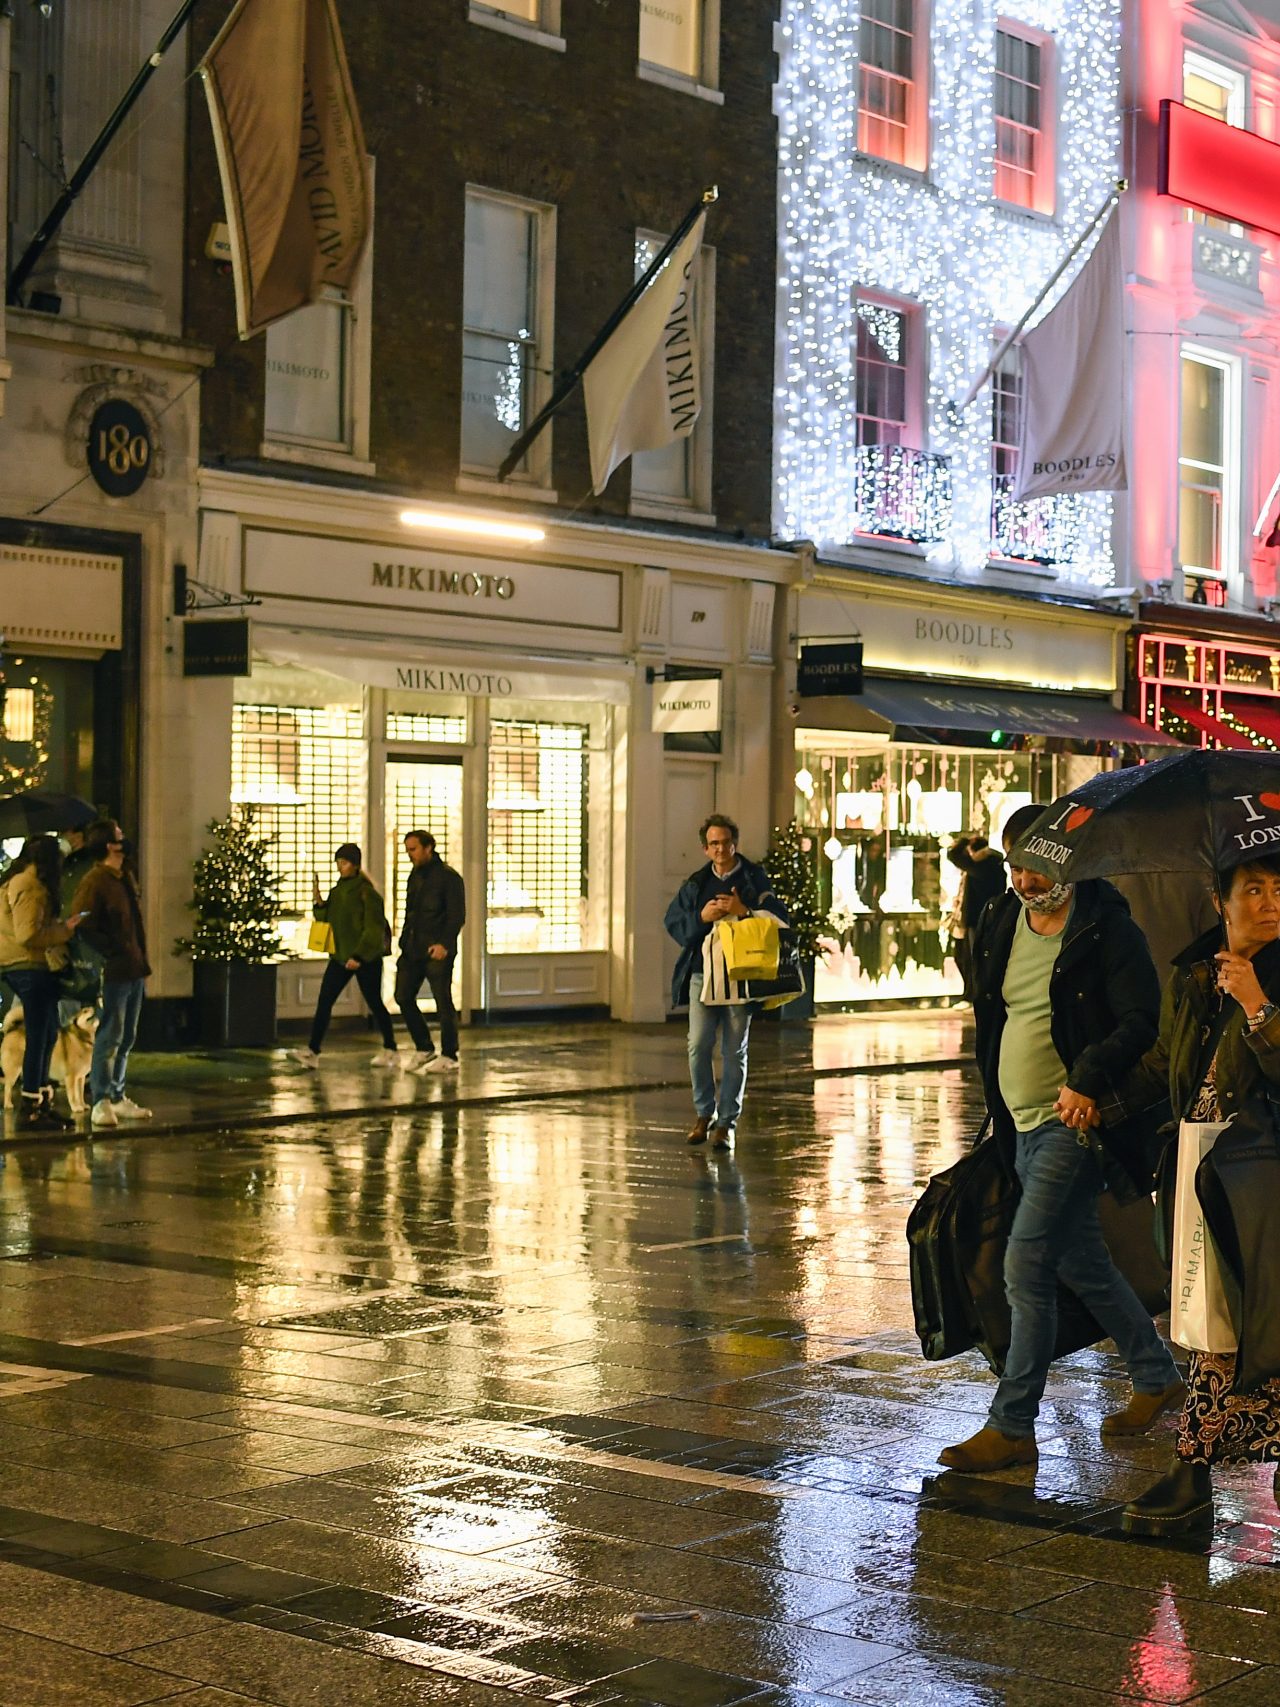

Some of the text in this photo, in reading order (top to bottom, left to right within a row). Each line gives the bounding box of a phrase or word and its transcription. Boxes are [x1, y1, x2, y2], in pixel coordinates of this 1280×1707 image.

[98, 424, 149, 475] 180
[1032, 453, 1116, 475] BOODLES
[372, 562, 515, 600] MIKIMOTO
[915, 618, 1014, 650] BOODLES
[397, 668, 512, 696] MIKIMOTO
[804, 663, 858, 675] BOODLES
[659, 700, 711, 711] MIKIMOTO
[1048, 802, 1079, 831] I
[1233, 794, 1266, 822] I
[1024, 836, 1073, 865] LONDON
[1180, 1216, 1204, 1312] PRIMARK
